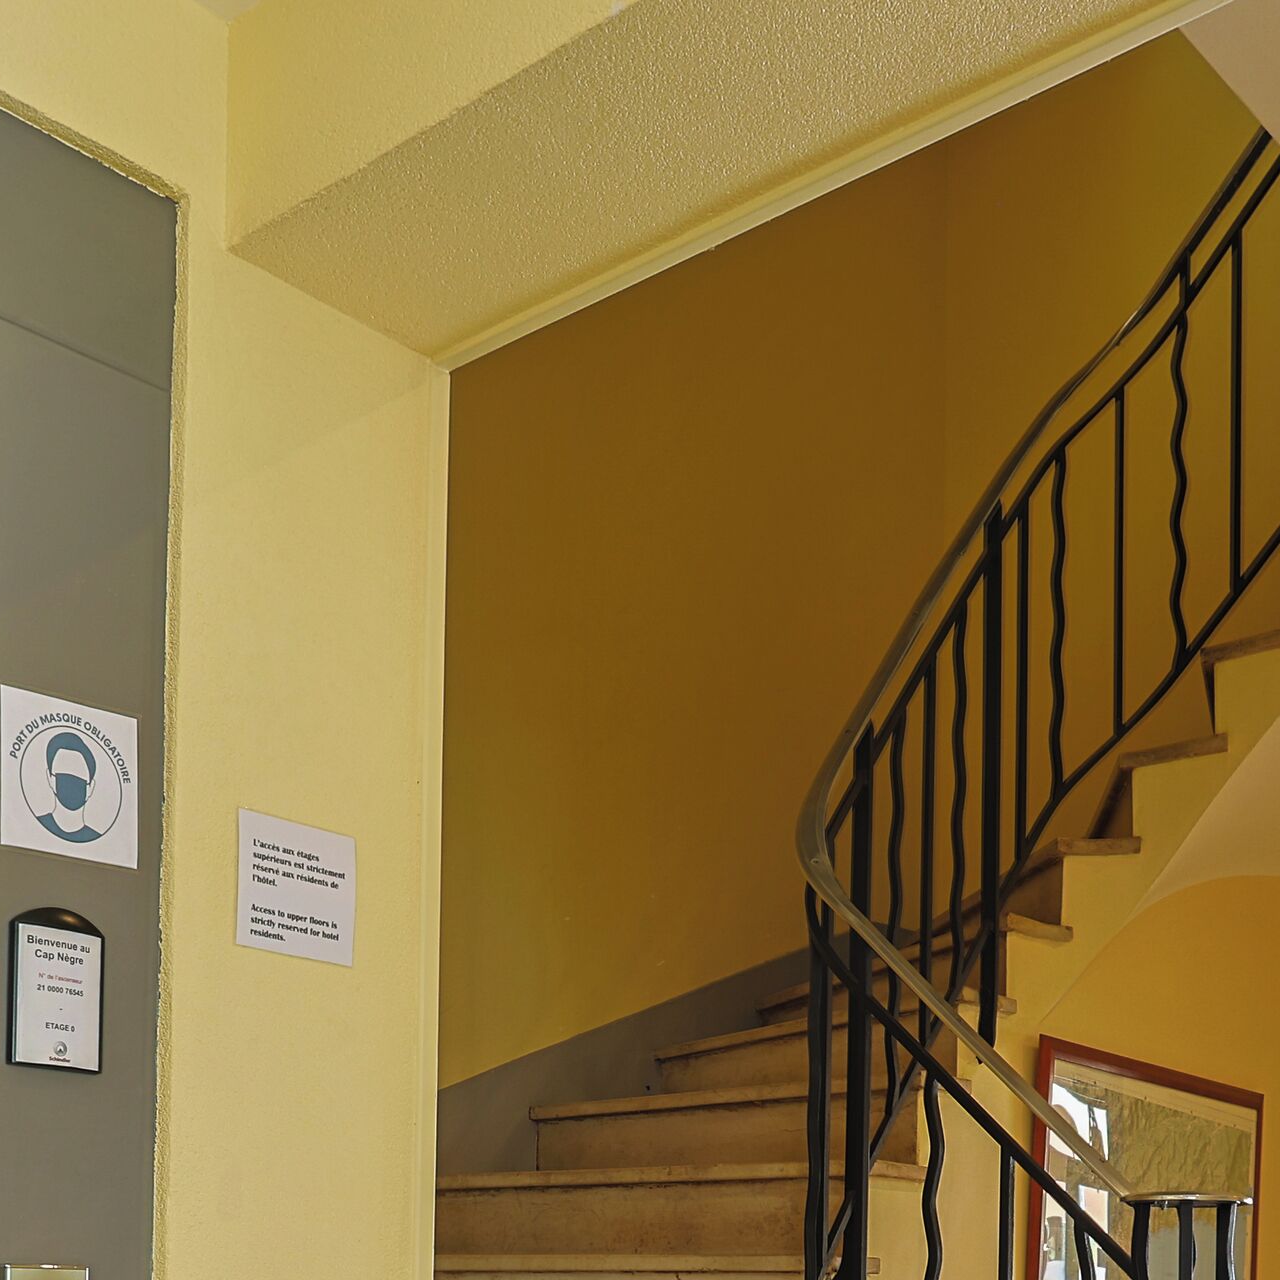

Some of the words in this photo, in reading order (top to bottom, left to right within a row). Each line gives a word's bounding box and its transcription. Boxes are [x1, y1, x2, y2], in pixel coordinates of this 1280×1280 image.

[9, 730, 29, 759] PORT
[25, 720, 40, 734] DU
[39, 713, 82, 726] MASQUE
[84, 721, 131, 784] OBLIGATOIRE
[282, 847, 295, 856] aux
[297, 849, 320, 862] étages
[253, 851, 292, 867] supérieurs
[294, 861, 304, 870] est
[306, 864, 346, 880] strictement
[252, 863, 280, 875] réservé
[282, 870, 295, 879] aux
[296, 872, 329, 887] résidents
[330, 880, 339, 889] de
[251, 903, 276, 916] Access
[277, 910, 285, 918] to
[286, 912, 307, 924] upper
[309, 915, 330, 927] floors
[331, 919, 337, 929] is
[250, 916, 275, 929] strictly
[278, 923, 308, 934] reserved
[310, 928, 320, 937] for
[322, 930, 339, 941] hotel
[250, 928, 286, 941] residents.
[26, 934, 78, 952] Bienvenue
[80, 944, 90, 954] au
[34, 948, 54, 961] Cap
[58, 952, 84, 966] Nègre
[37, 984, 45, 992] 21
[47, 985, 64, 994] 0000
[65, 987, 84, 997] 76545
[46, 1022, 70, 1032] ETAGE
